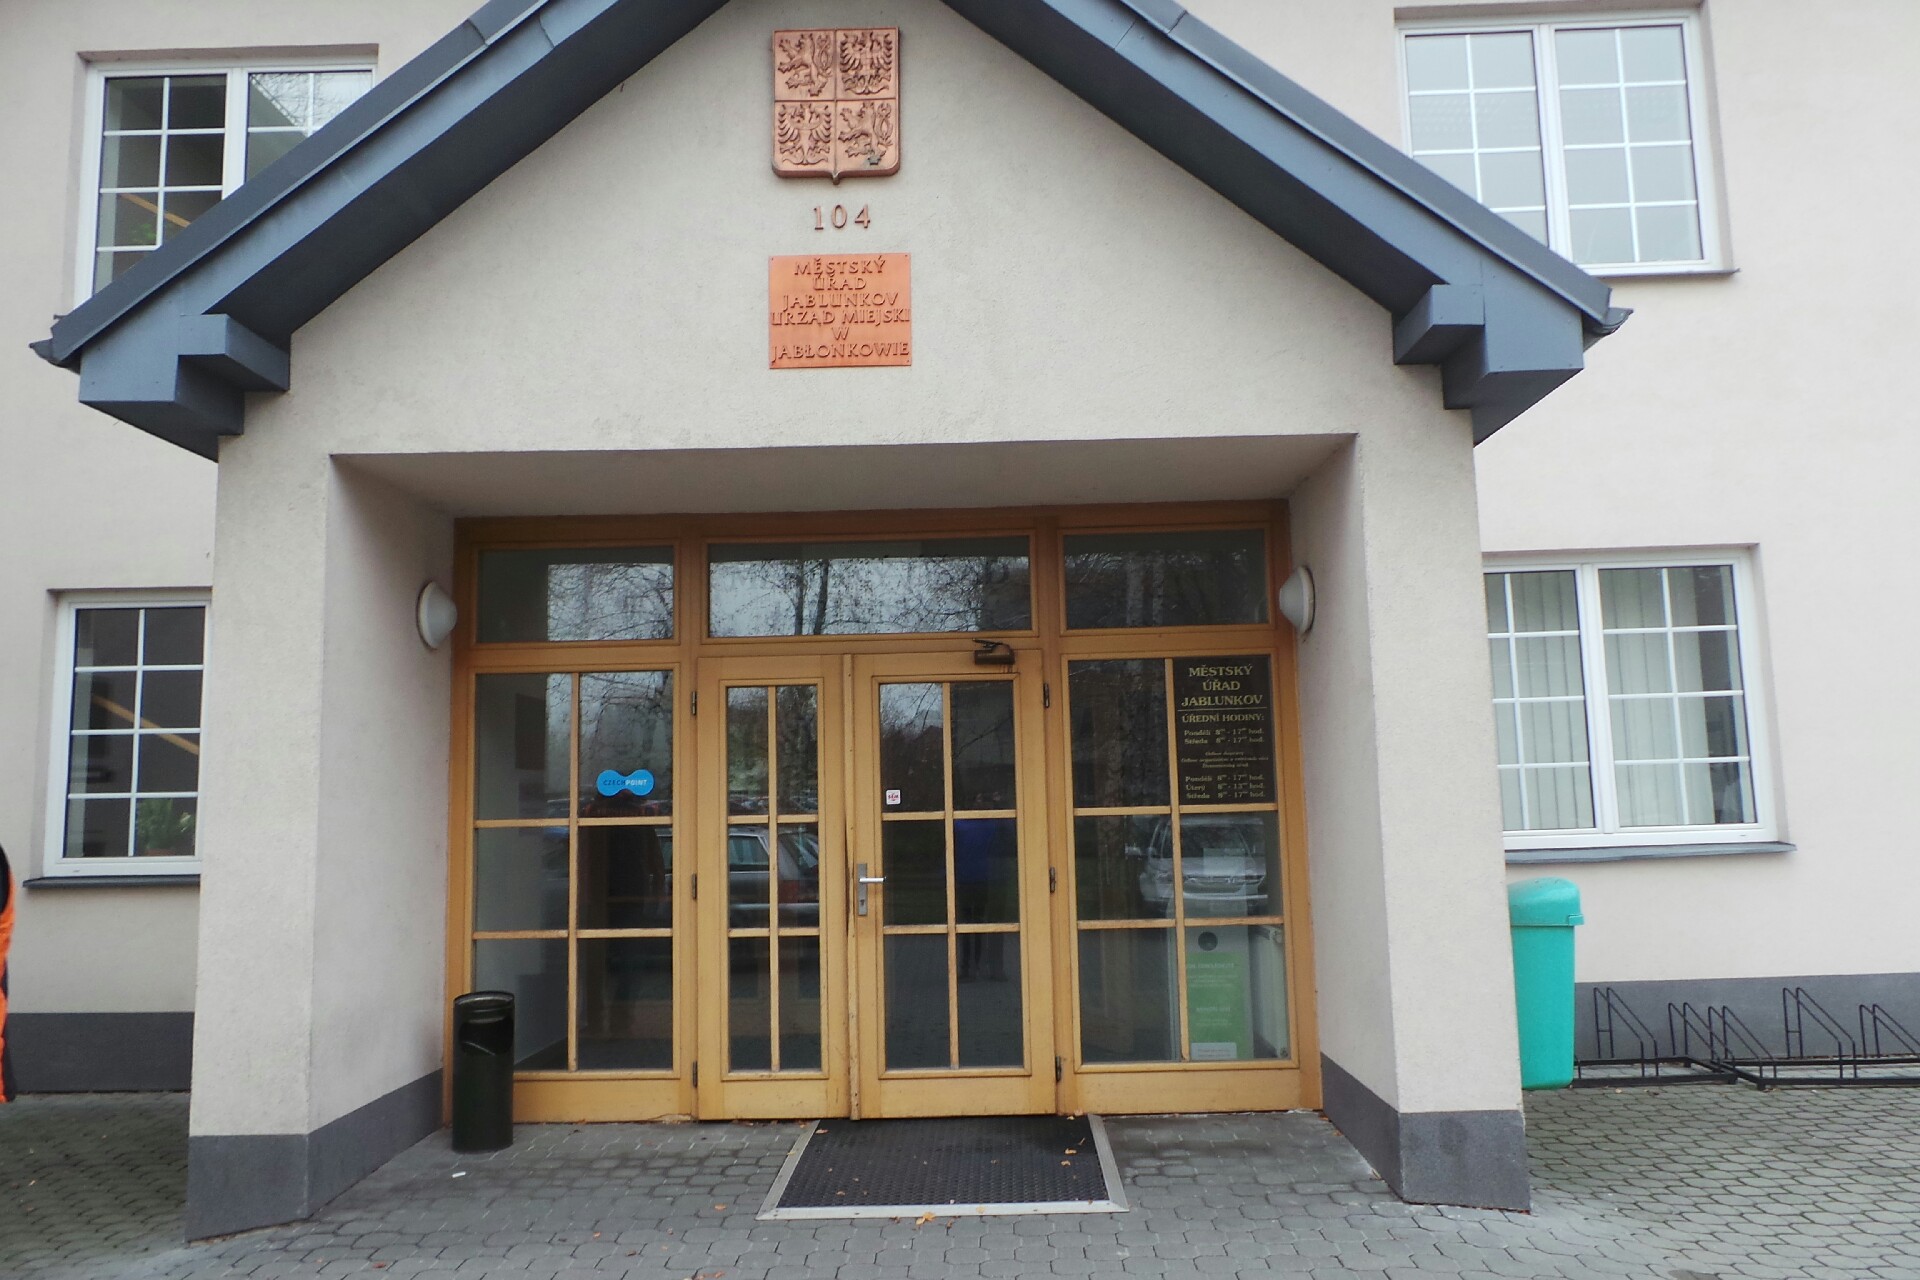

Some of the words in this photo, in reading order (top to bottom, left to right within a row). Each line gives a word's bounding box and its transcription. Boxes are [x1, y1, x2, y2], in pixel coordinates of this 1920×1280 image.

[814, 204, 871, 231] 104
[794, 255, 887, 276] MĚSTSKÝ
[813, 273, 867, 291] ÚŘAD
[783, 293, 899, 312] JABLUNKOV
[841, 308, 911, 326] MIEJSKI
[832, 327, 850, 341] W
[1189, 664, 1253, 677] MĚSTSKÝ
[1202, 679, 1241, 691] ÚŘAD
[1181, 694, 1263, 707] JABLUNKOV
[1182, 713, 1220, 723] ÚŘEDNÍ
[1222, 713, 1265, 722] HODINY:
